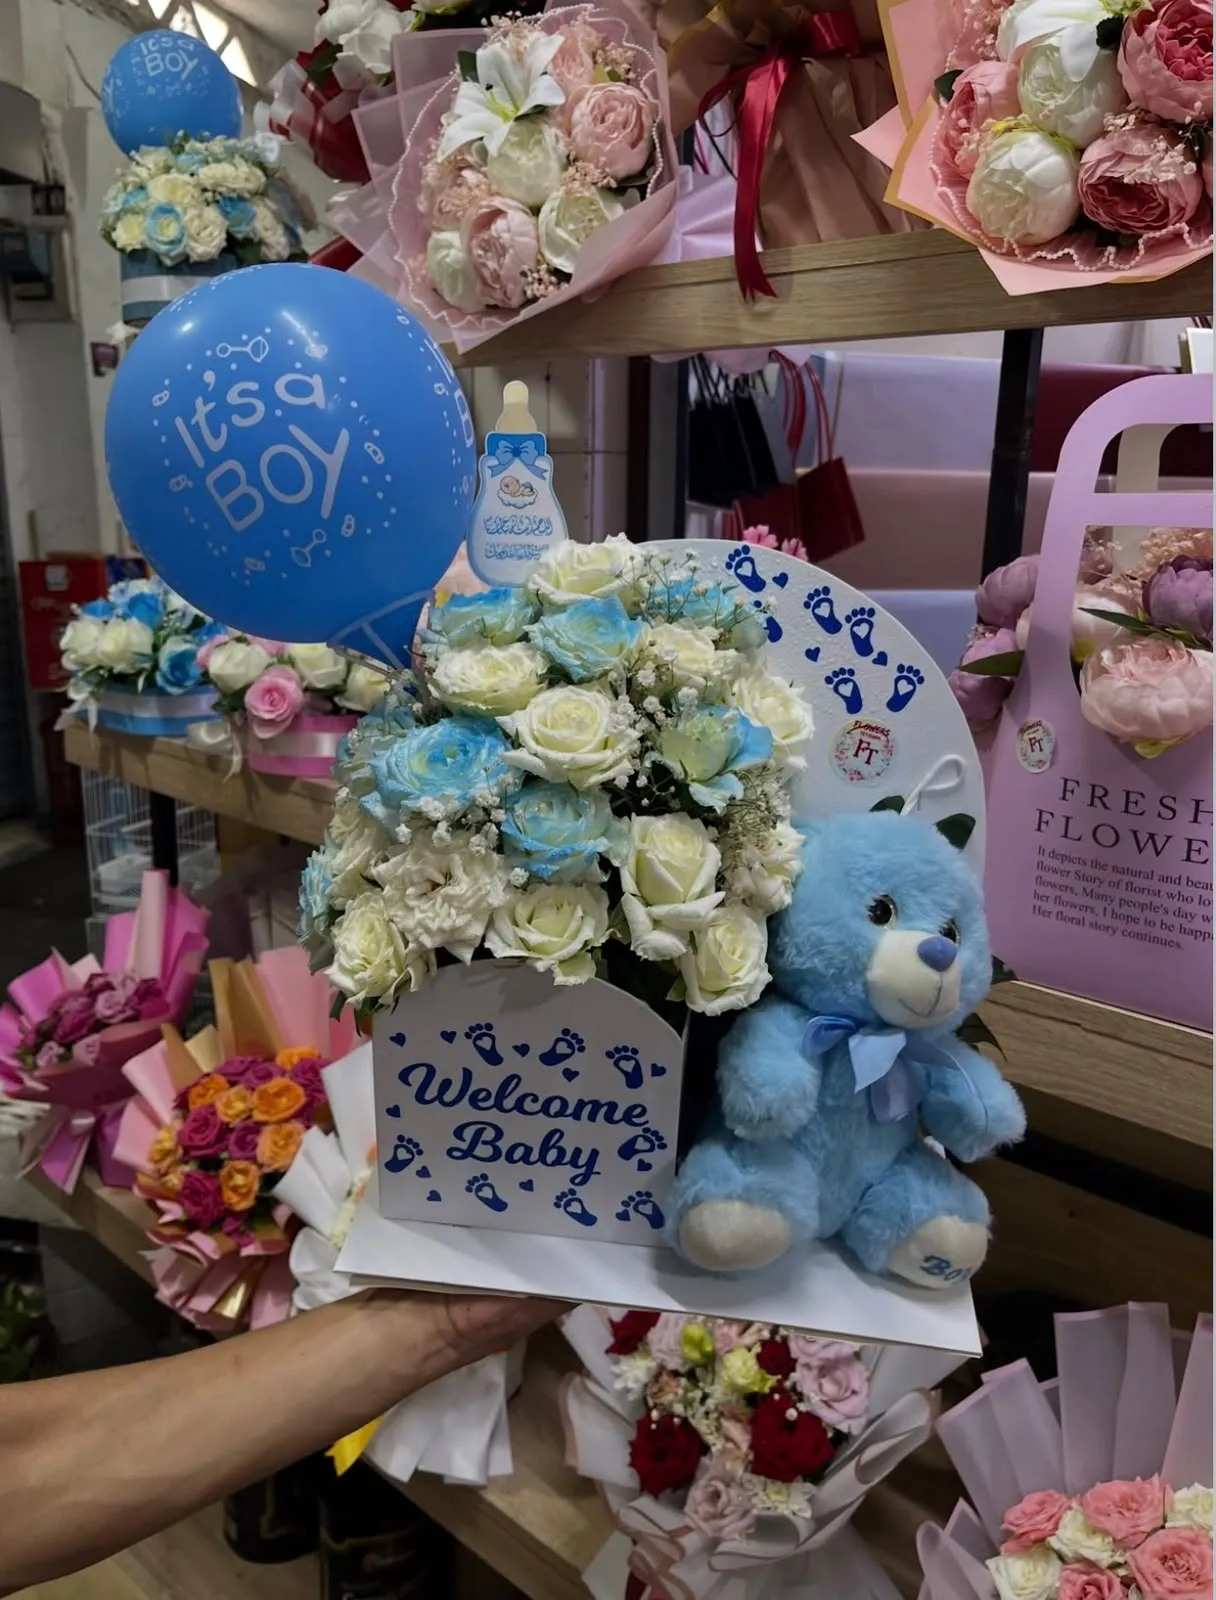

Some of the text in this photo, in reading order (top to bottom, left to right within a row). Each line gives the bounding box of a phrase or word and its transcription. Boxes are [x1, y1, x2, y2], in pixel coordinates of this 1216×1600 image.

[144, 51, 198, 81] BOY
[174, 369, 326, 468] It's a
[205, 424, 350, 532] BOY
[853, 739, 879, 765] FT
[1058, 776, 1213, 826] FRESH
[1034, 808, 1209, 865] FLOWE
[1036, 860, 1213, 908] flower Story of florist who lo
[1038, 845, 1046, 857] It
[1048, 848, 1087, 867] depicts
[1090, 858, 1109, 872] the
[1111, 864, 1155, 881] natural
[1158, 874, 1182, 886] and
[1032, 904, 1053, 918] Her
[1055, 910, 1086, 928] floral
[1088, 920, 1119, 937] story
[1033, 888, 1051, 903] her
[1102, 906, 1108, 917] I
[1110, 907, 1141, 926] hope
[1144, 917, 1157, 929] to
[1160, 918, 1176, 933] be
[1082, 887, 1116, 907] Many
[1118, 897, 1169, 915] people's
[1172, 906, 1197, 923] day
[397, 1062, 649, 1127] Welcome
[446, 1120, 601, 1187] Baby
